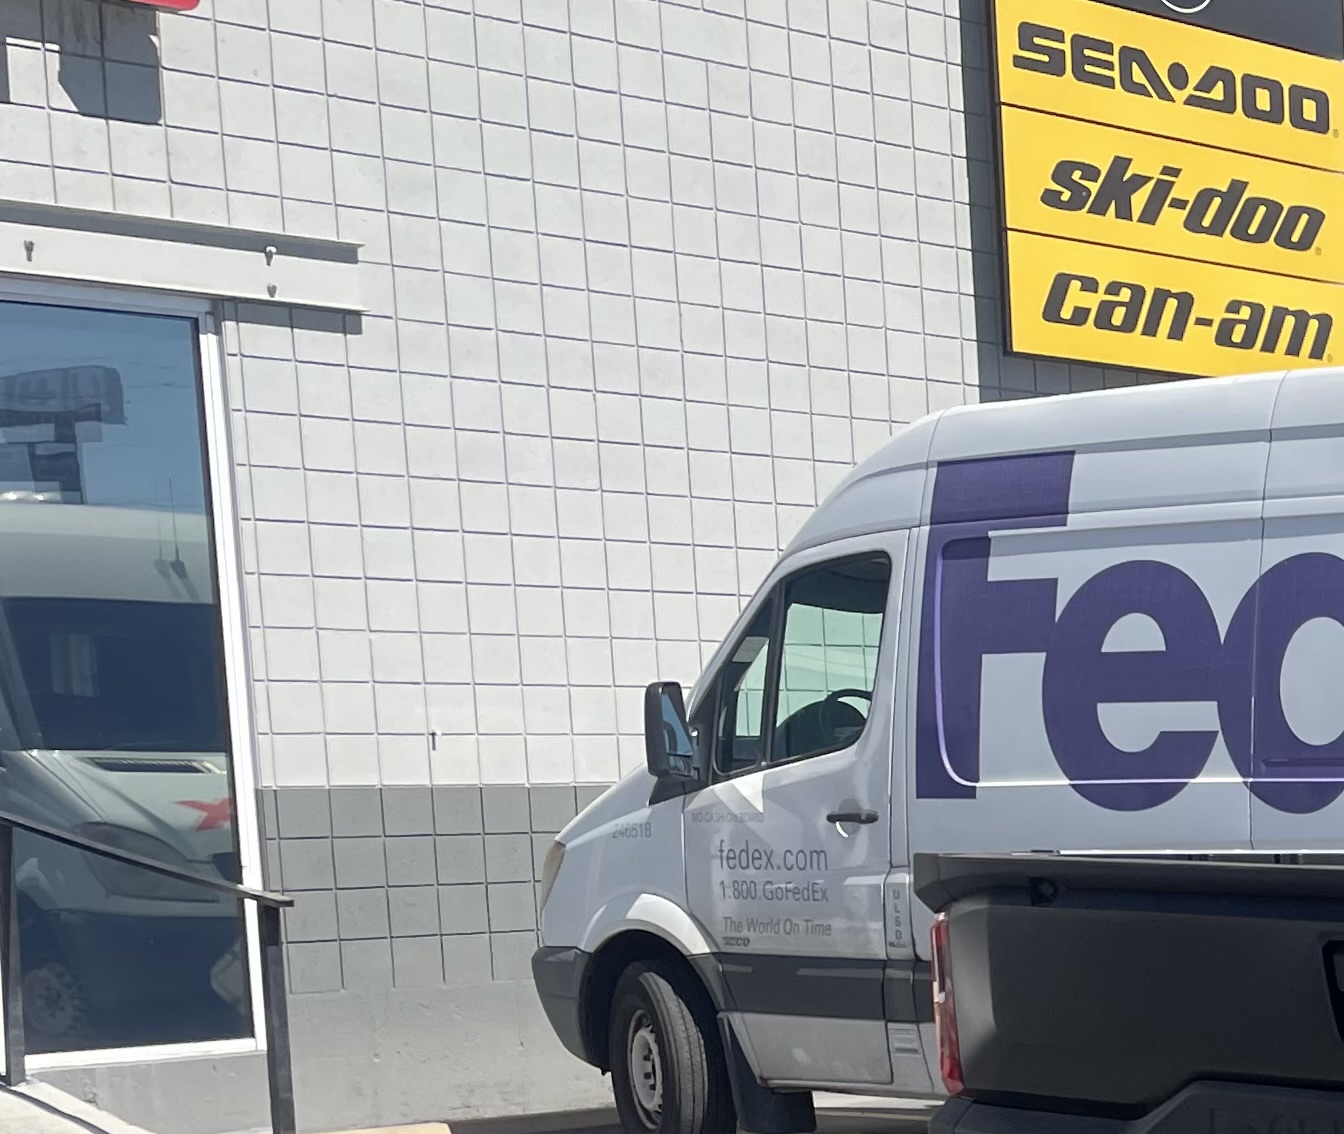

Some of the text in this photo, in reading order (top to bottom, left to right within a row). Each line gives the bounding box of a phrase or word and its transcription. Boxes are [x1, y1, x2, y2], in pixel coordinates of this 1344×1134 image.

[1040, 154, 1326, 252] ski-doo
[718, 839, 828, 871] fedex.com
[722, 916, 832, 937] The World On Time
